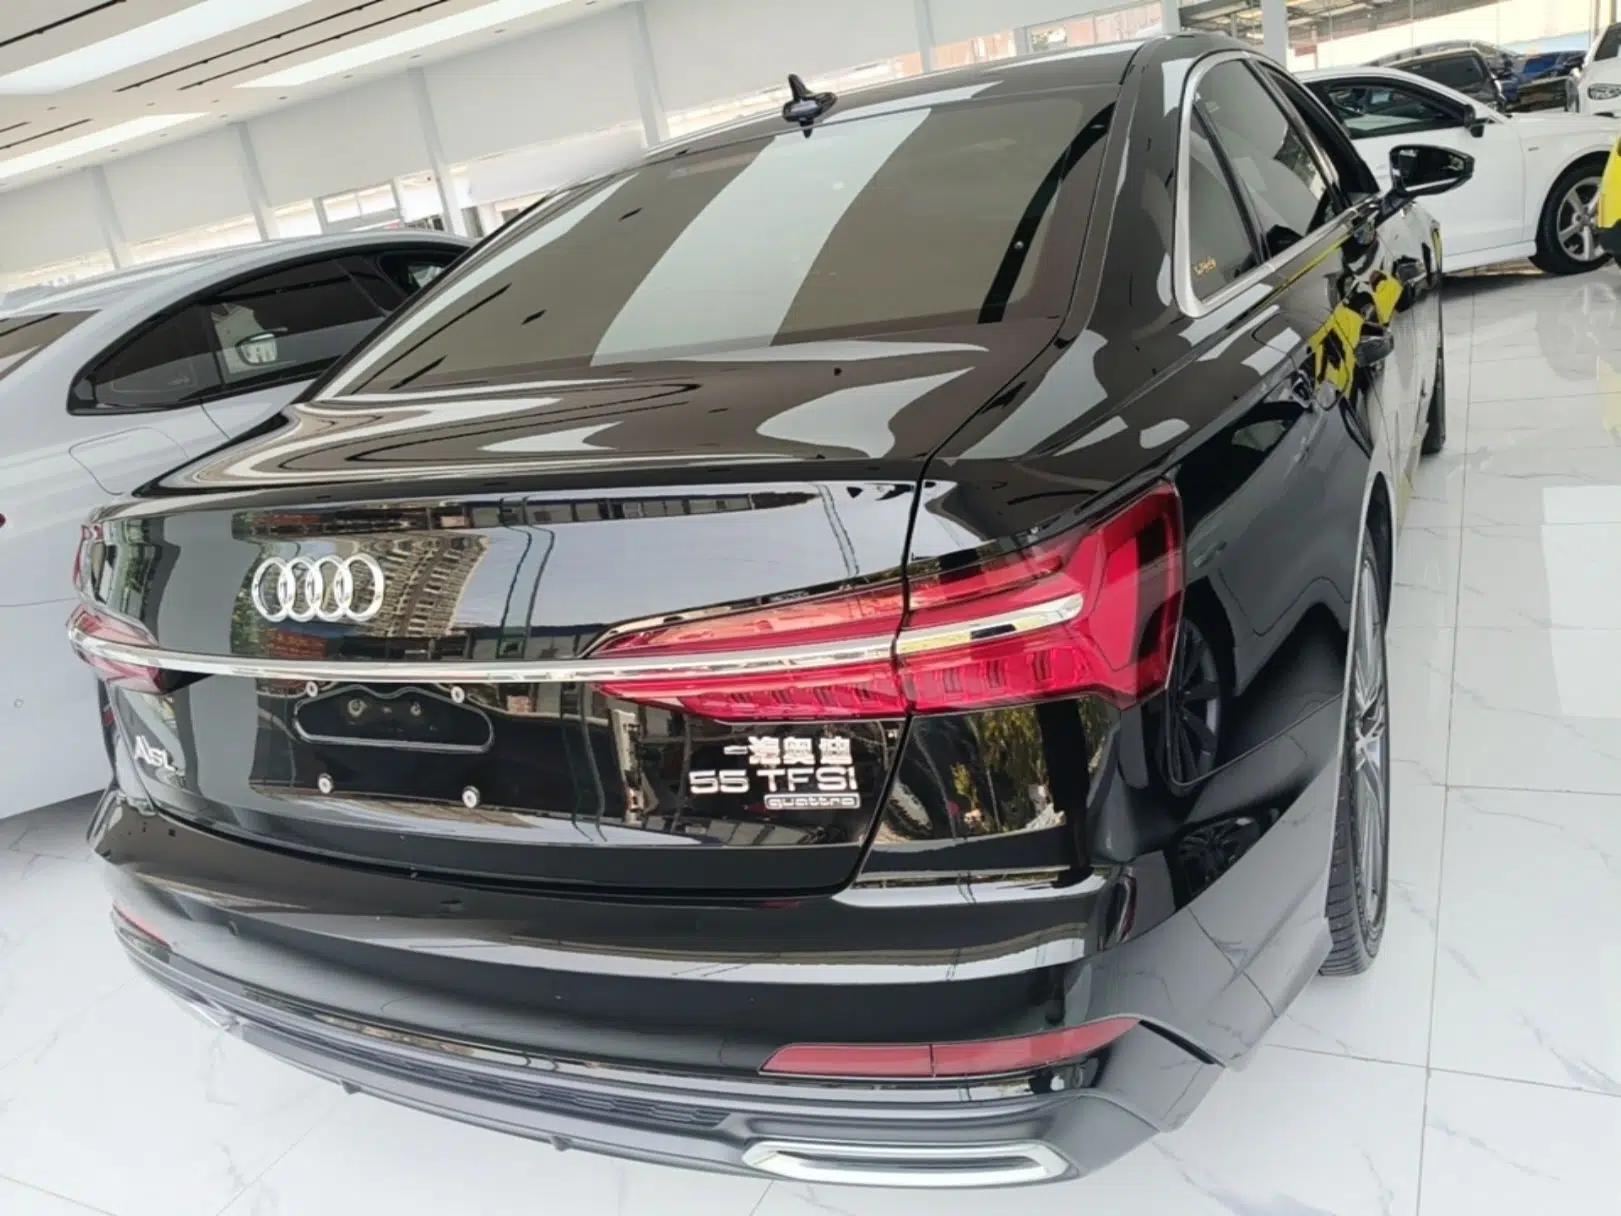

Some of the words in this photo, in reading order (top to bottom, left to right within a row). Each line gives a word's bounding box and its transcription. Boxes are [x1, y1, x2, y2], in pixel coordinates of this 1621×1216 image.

[688, 769, 750, 794] 55
[756, 766, 859, 792] TFSI
[768, 795, 855, 810] quattro
